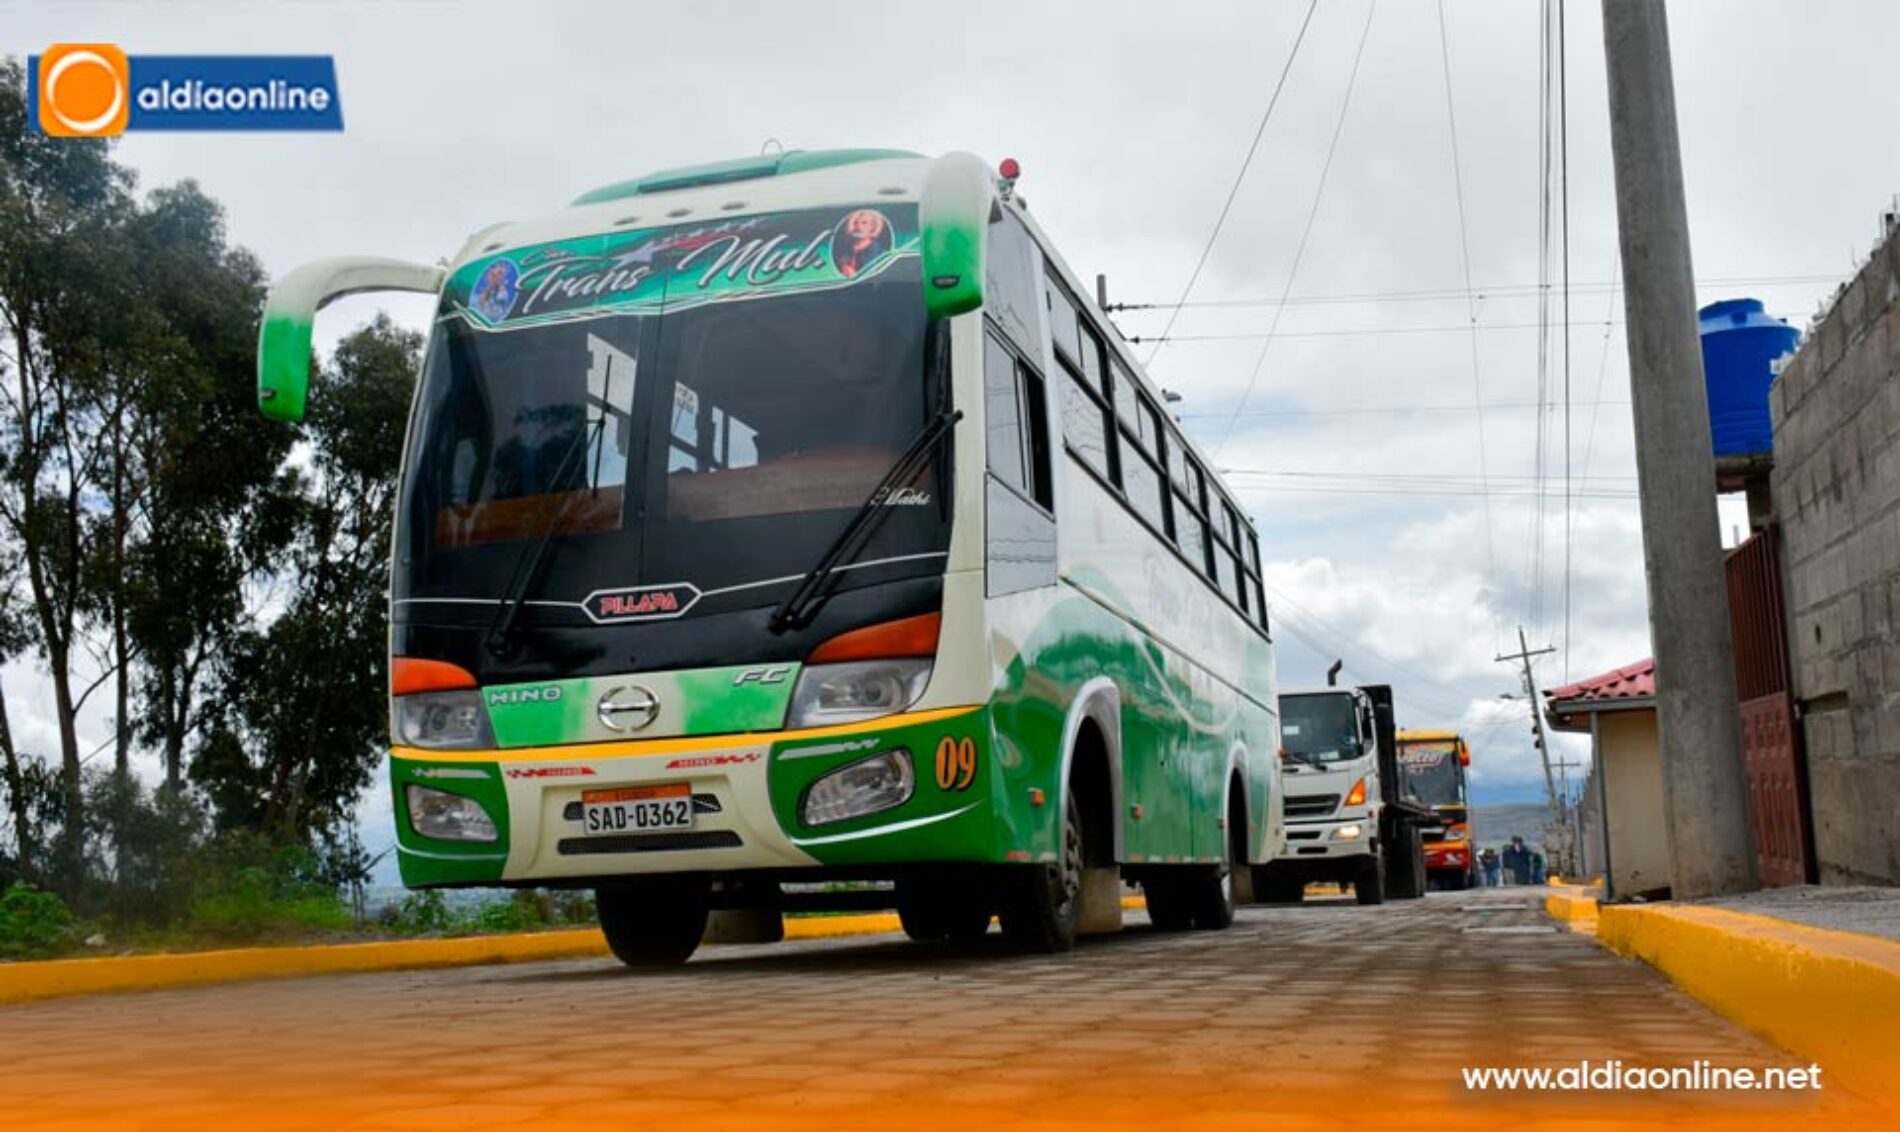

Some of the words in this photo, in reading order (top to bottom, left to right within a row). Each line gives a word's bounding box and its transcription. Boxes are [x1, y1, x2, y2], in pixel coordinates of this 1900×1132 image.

[514, 257, 651, 314] Trans
[733, 664, 789, 686] FC
[490, 686, 562, 706] HINO
[934, 736, 977, 791] 09
[588, 801, 689, 831] SAD-0362
